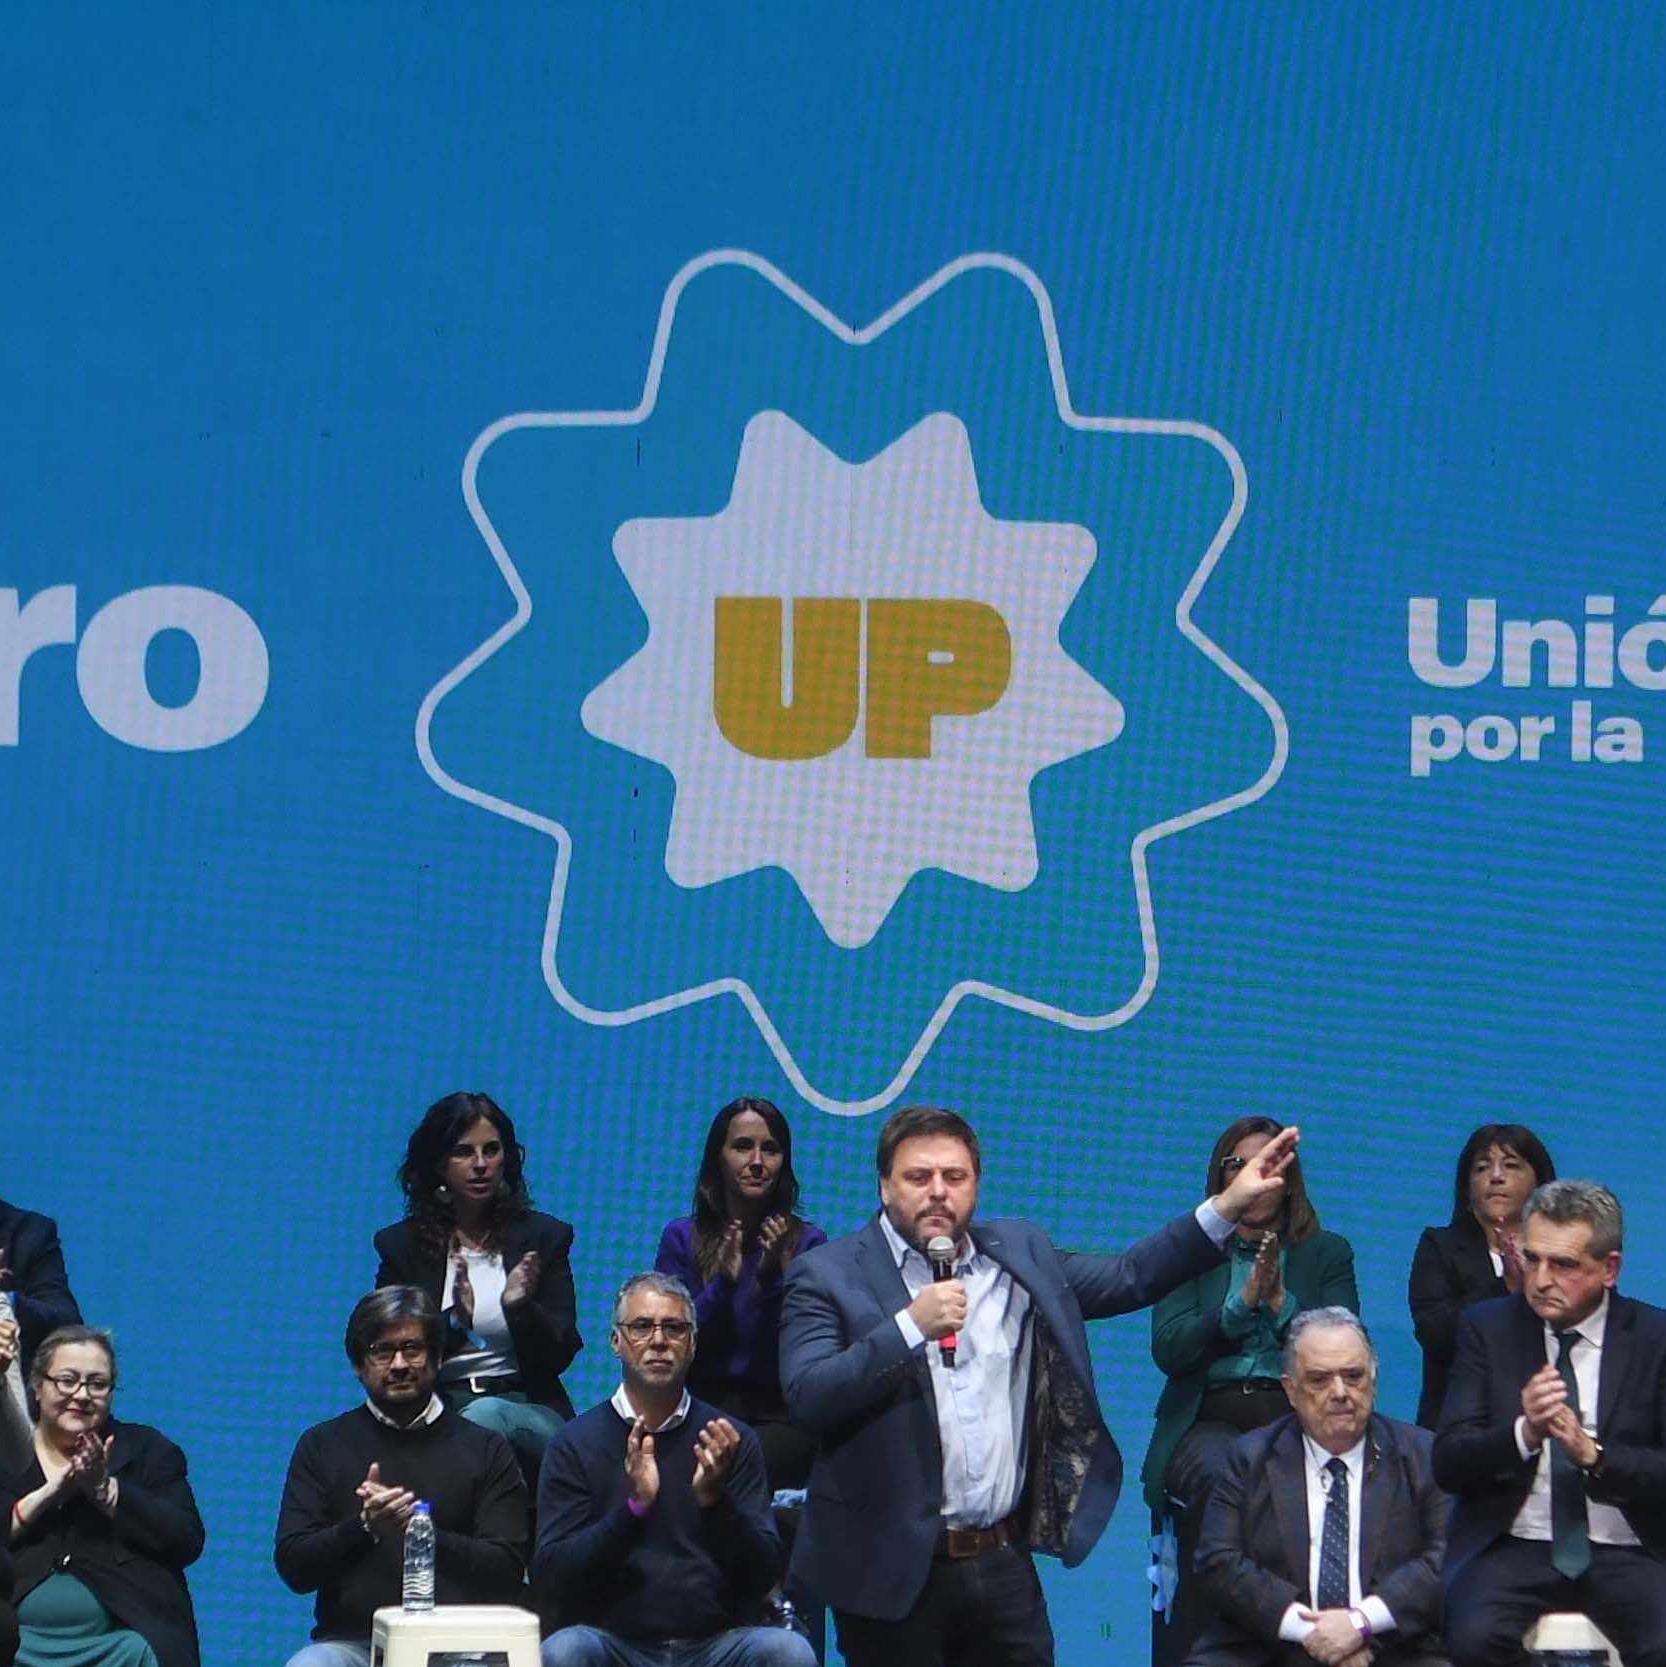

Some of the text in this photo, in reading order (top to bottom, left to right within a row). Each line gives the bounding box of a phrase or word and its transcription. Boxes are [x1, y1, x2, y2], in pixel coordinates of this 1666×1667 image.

[712, 595, 1012, 762] UP
[1410, 700, 1644, 776] por la
